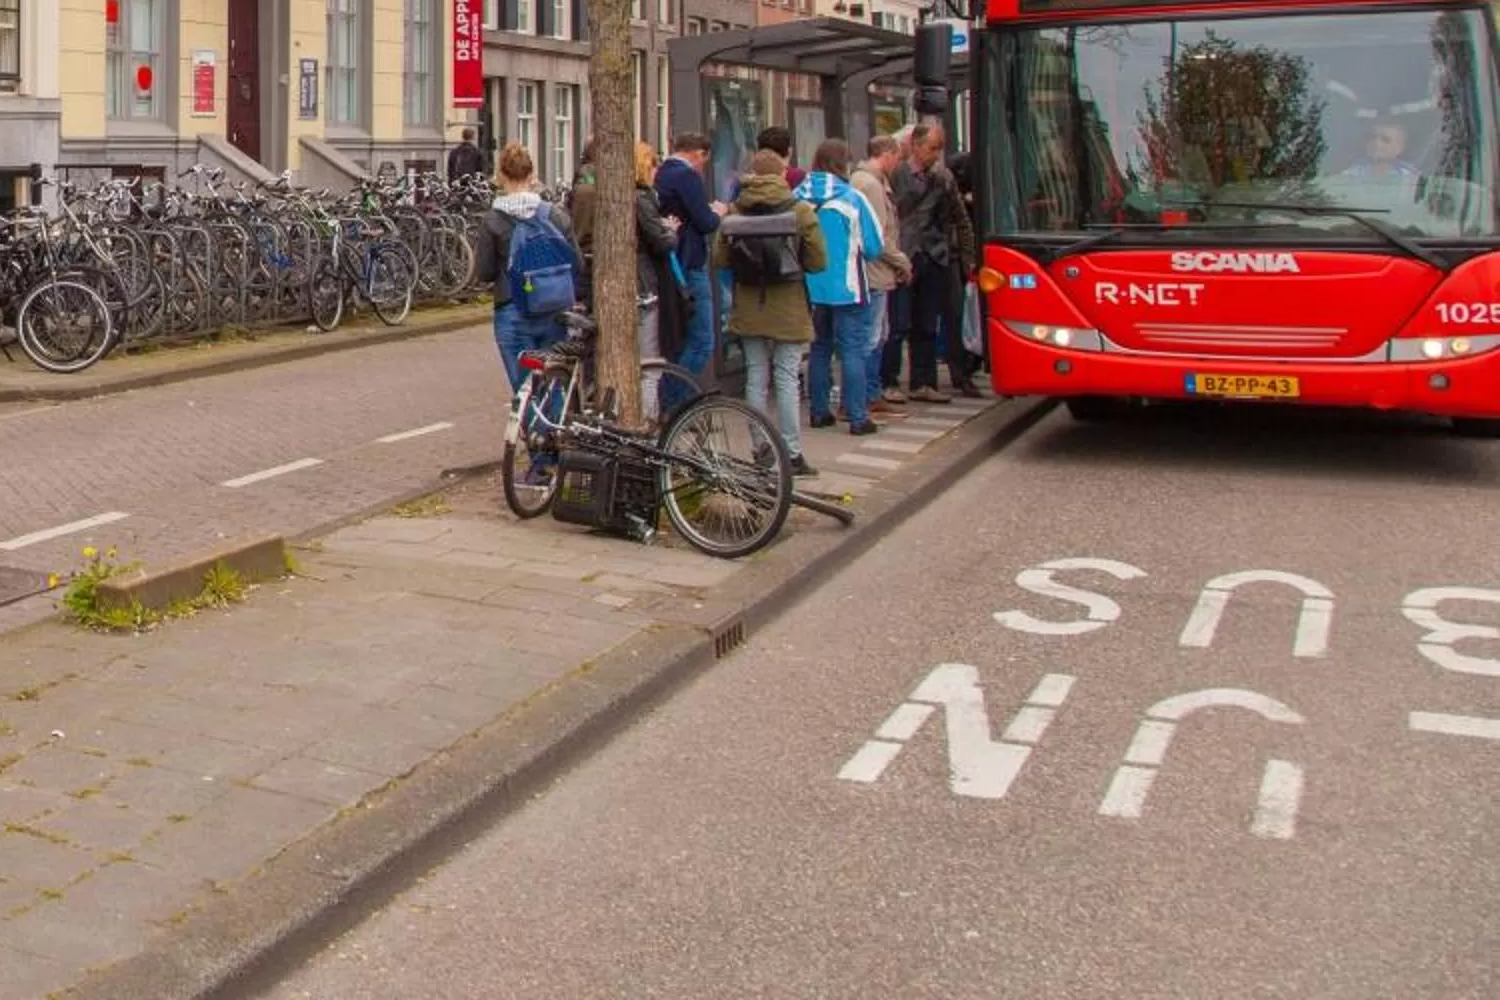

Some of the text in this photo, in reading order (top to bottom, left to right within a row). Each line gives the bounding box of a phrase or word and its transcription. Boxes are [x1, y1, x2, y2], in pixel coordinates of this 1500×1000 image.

[456, 39, 471, 61] DE
[1171, 251, 1300, 273] SCANIA
[1204, 377, 1292, 393] BZ-PP-43
